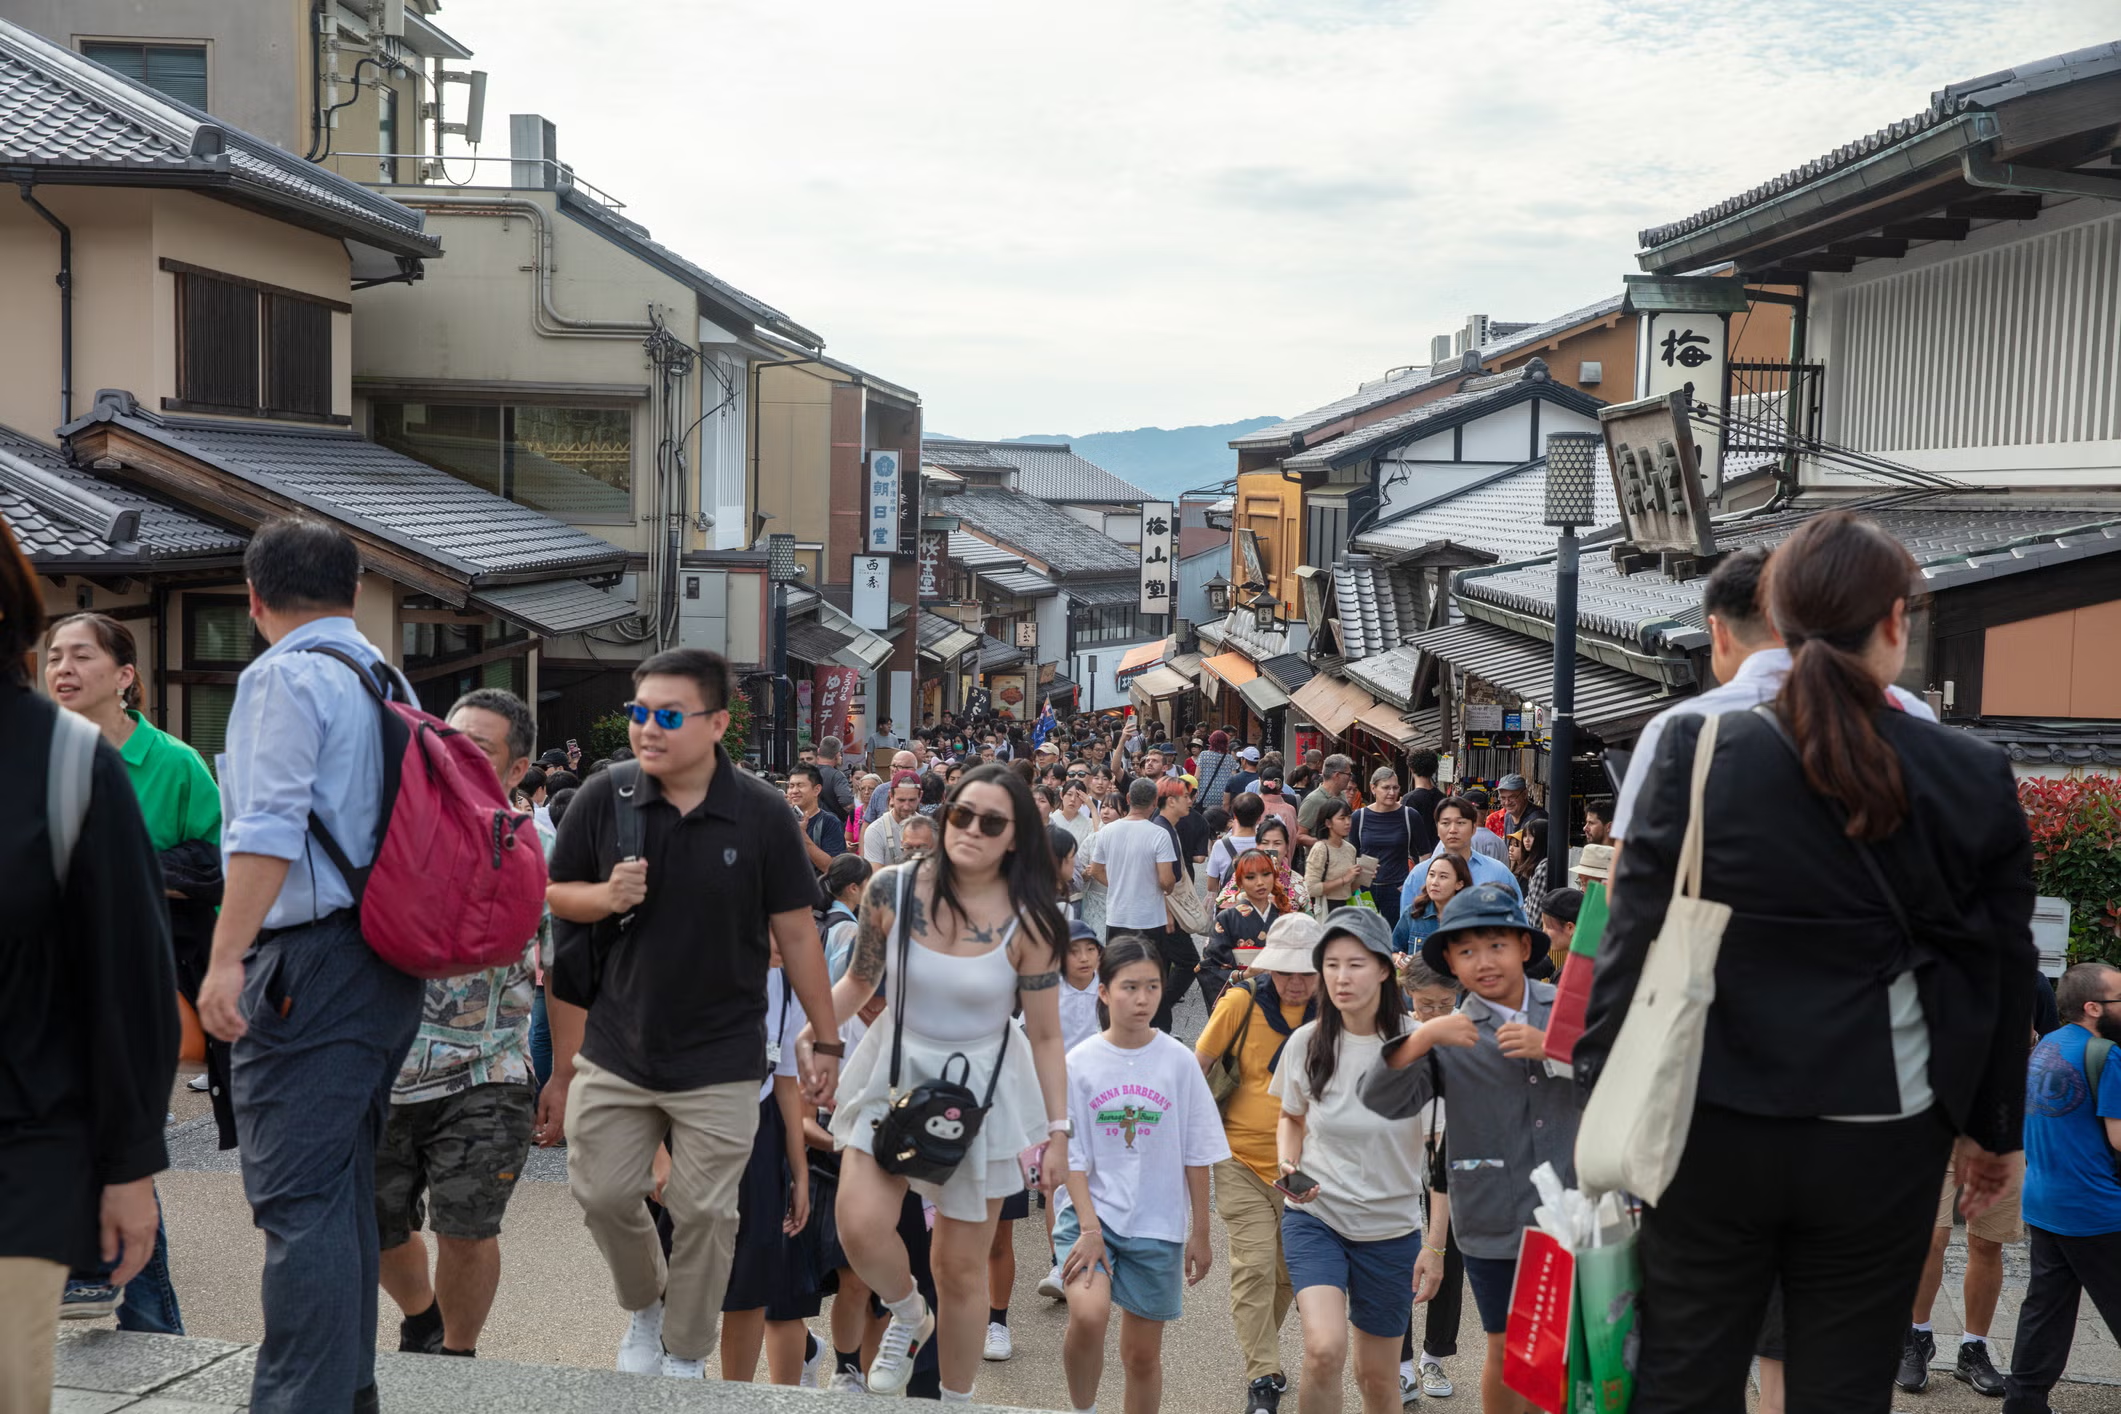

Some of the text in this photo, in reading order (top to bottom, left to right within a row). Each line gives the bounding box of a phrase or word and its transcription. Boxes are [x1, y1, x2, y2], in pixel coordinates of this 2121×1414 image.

[873, 481, 889, 545] 朝日堂
[866, 558, 879, 589] 西秀
[1145, 516, 1169, 600] 梅山堂
[839, 671, 853, 701] とろける
[1089, 1084, 1172, 1111] WANNA BARBERA'S
